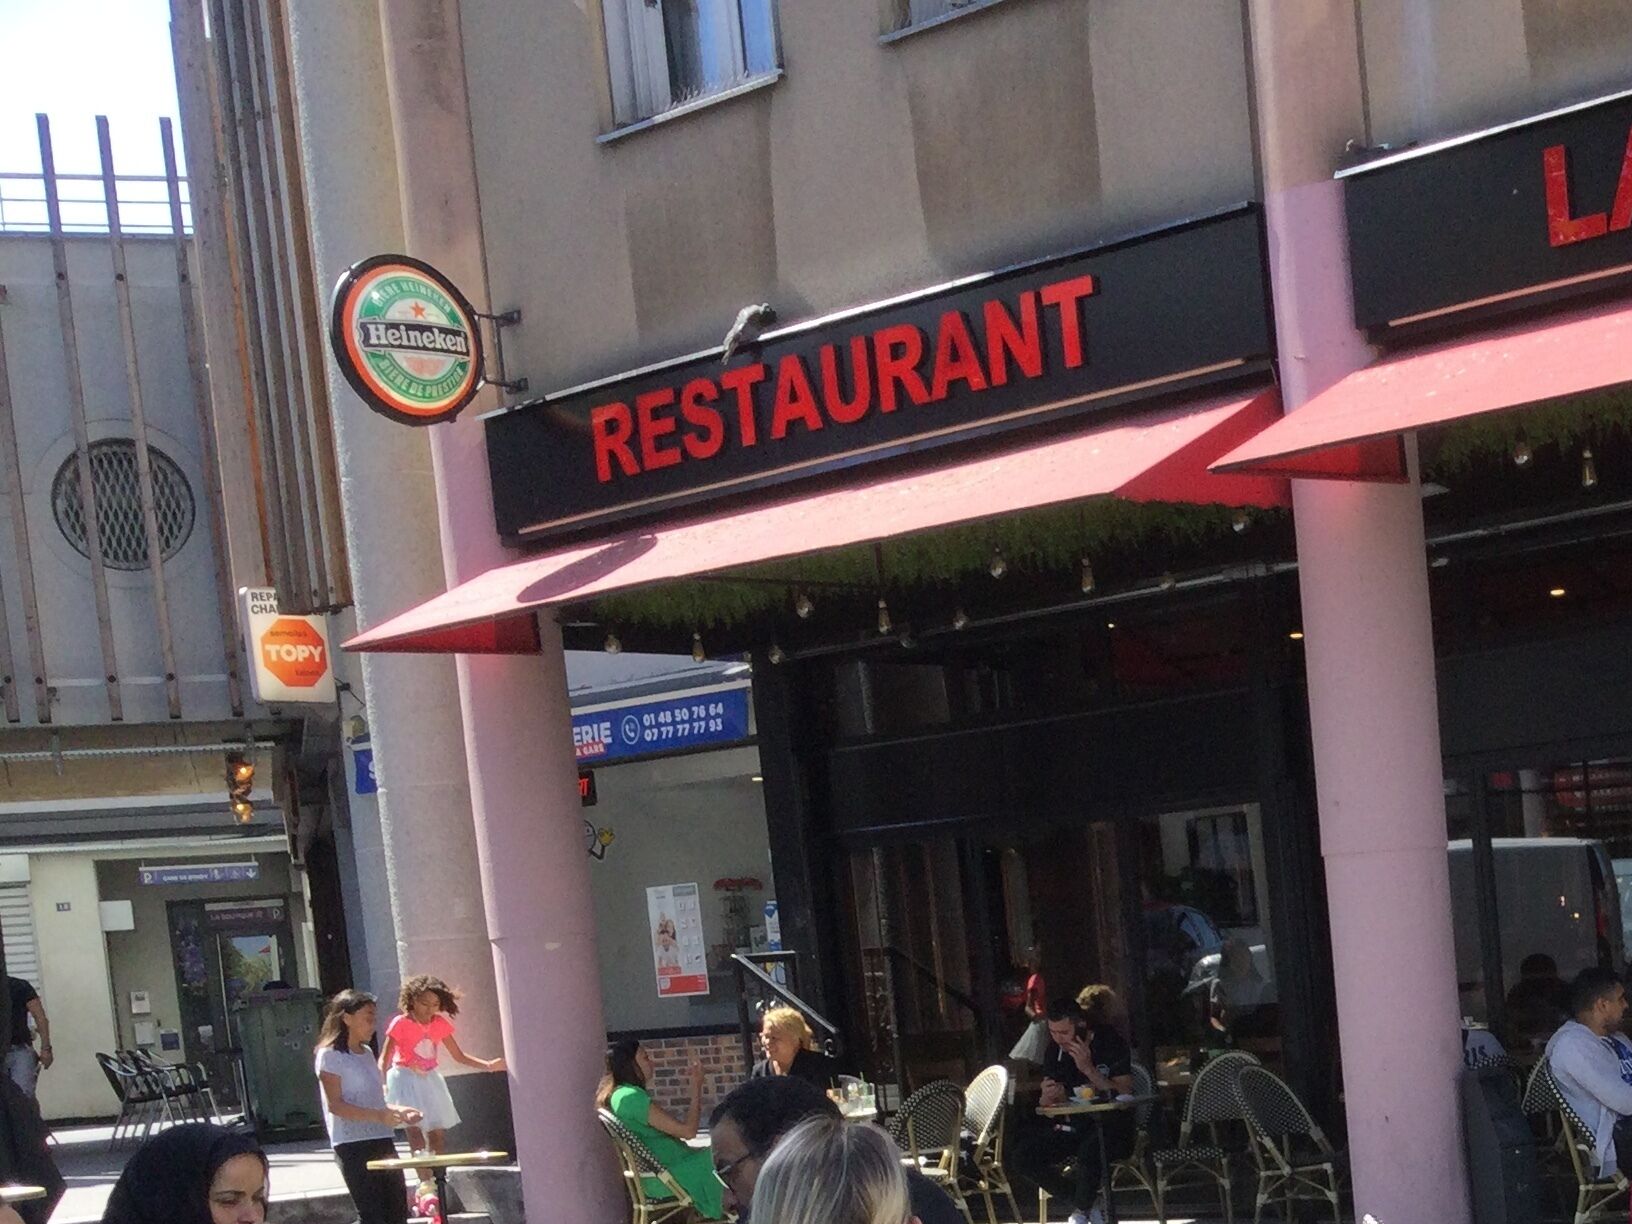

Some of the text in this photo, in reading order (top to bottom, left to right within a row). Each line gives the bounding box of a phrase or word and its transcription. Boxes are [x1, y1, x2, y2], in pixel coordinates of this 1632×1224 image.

[366, 323, 468, 353] Heineken
[591, 275, 1094, 482] RESTAURANT
[264, 643, 323, 663] TOPY
[643, 702, 724, 727] 01 48 50 76 64
[644, 718, 723, 742] 07 77 77 77 93
